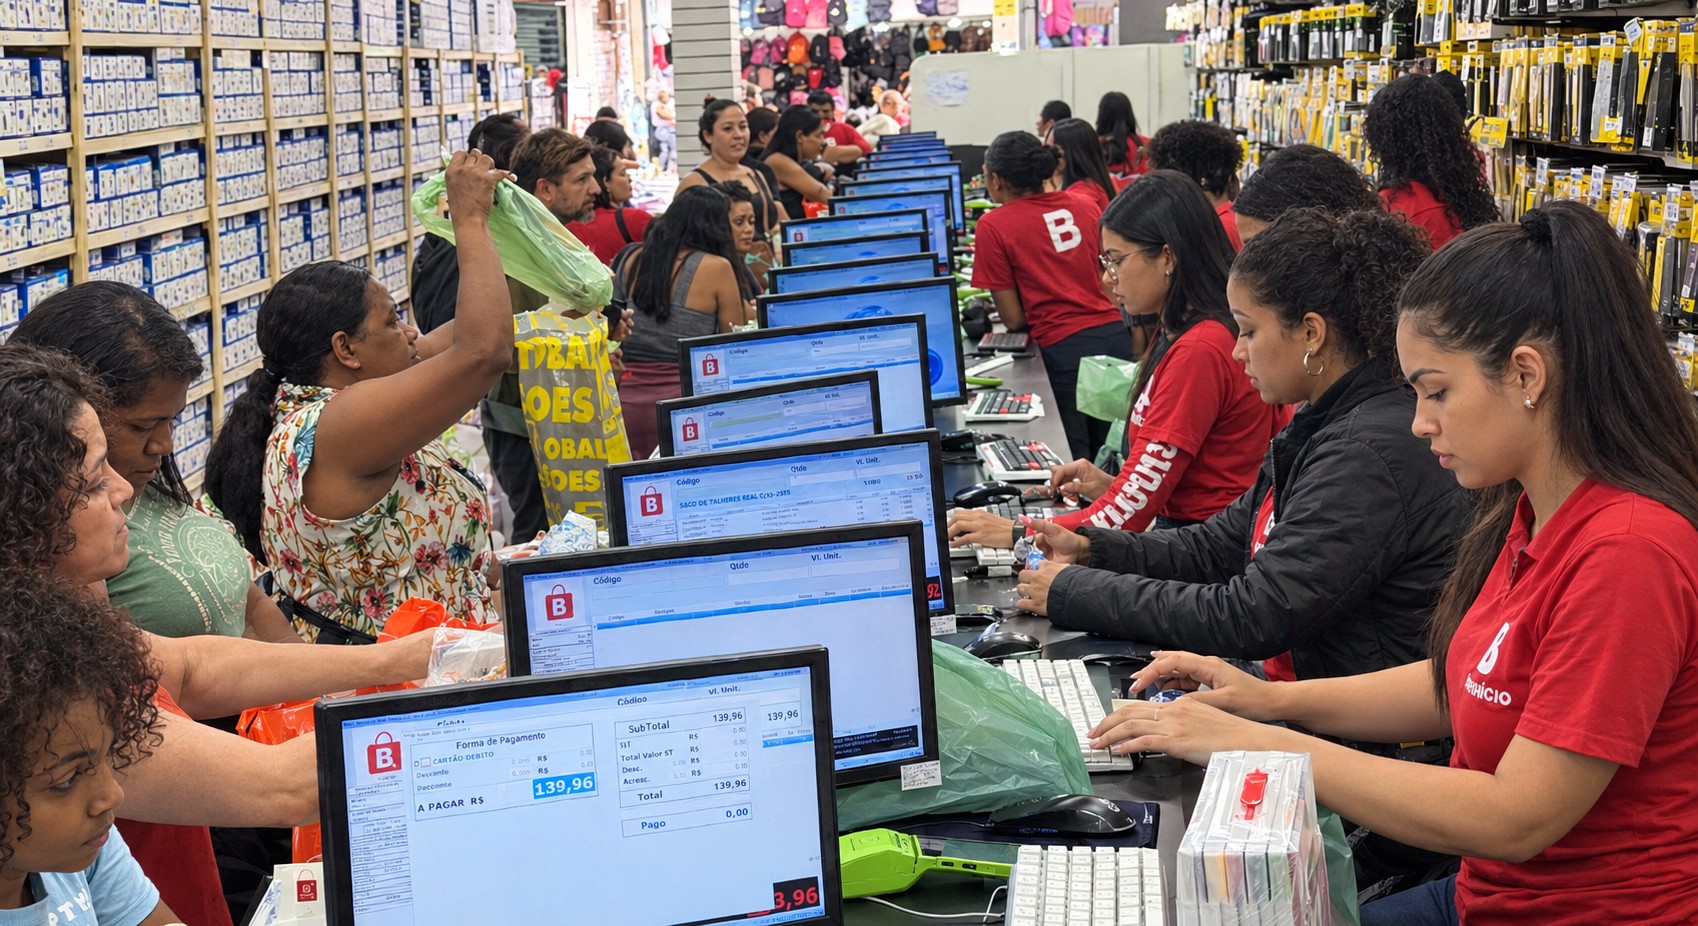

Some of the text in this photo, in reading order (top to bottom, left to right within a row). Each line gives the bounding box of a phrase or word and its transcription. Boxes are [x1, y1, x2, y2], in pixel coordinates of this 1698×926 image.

[1042, 208, 1082, 253] B
[706, 362, 715, 372] B
[686, 427, 695, 438] B
[646, 498, 658, 513] B
[593, 576, 622, 585] Código
[552, 597, 567, 616] B
[1476, 622, 1510, 674] B
[628, 712, 743, 734] SubTotal 139,96
[768, 709, 799, 721] 139,96
[456, 740, 484, 750] Forma
[500, 732, 546, 745] Pagamento
[433, 754, 463, 764] CARTÃO
[621, 753, 641, 762] Total
[643, 751, 663, 759] Valor
[417, 776, 593, 812] A PAGAR R$ 139,96
[638, 779, 746, 801] Total 139,96
[641, 808, 748, 830] Pago 0,00
